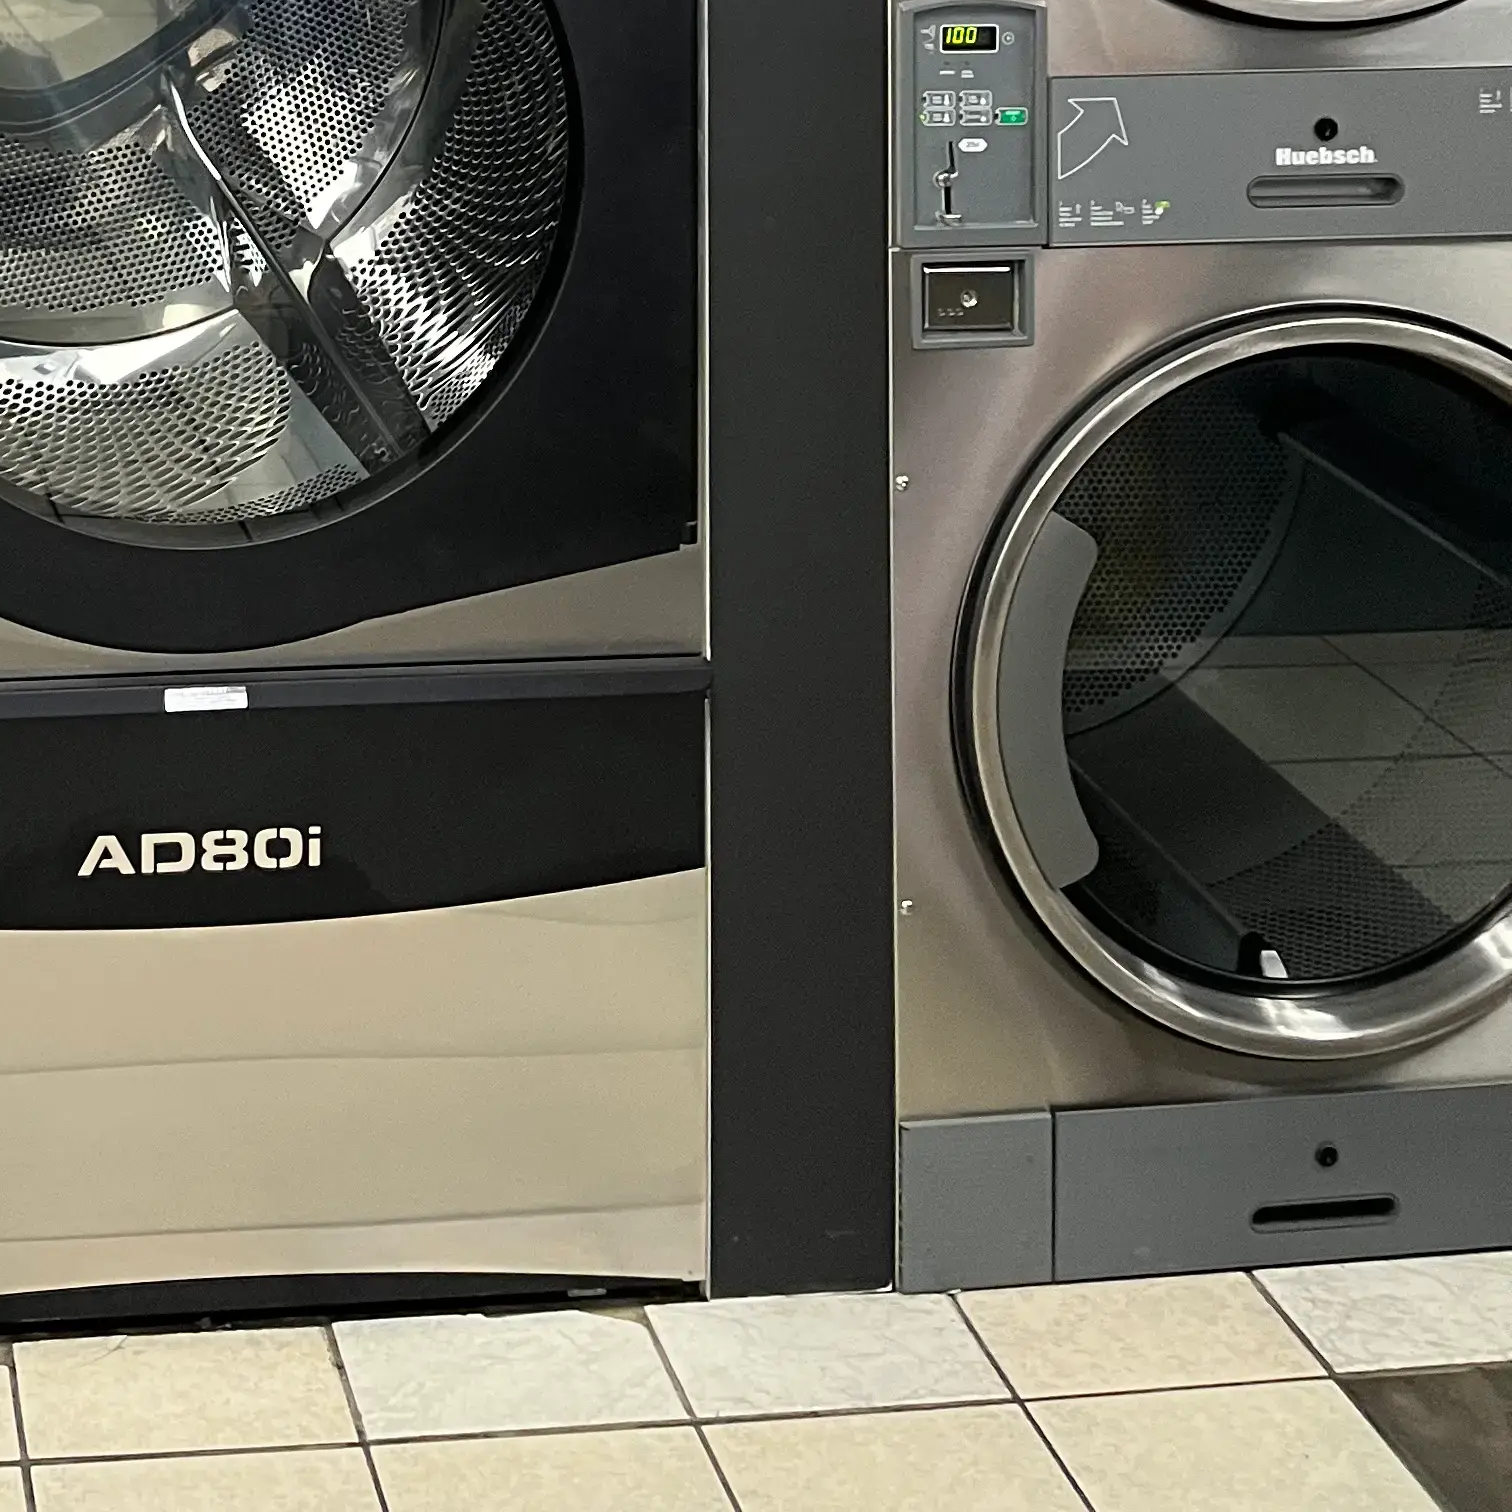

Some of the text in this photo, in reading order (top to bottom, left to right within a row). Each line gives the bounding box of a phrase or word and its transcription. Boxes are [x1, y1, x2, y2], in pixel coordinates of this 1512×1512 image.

[945, 26, 978, 44] 100
[1275, 146, 1376, 166] Huebsch
[77, 825, 322, 877] AD80i
